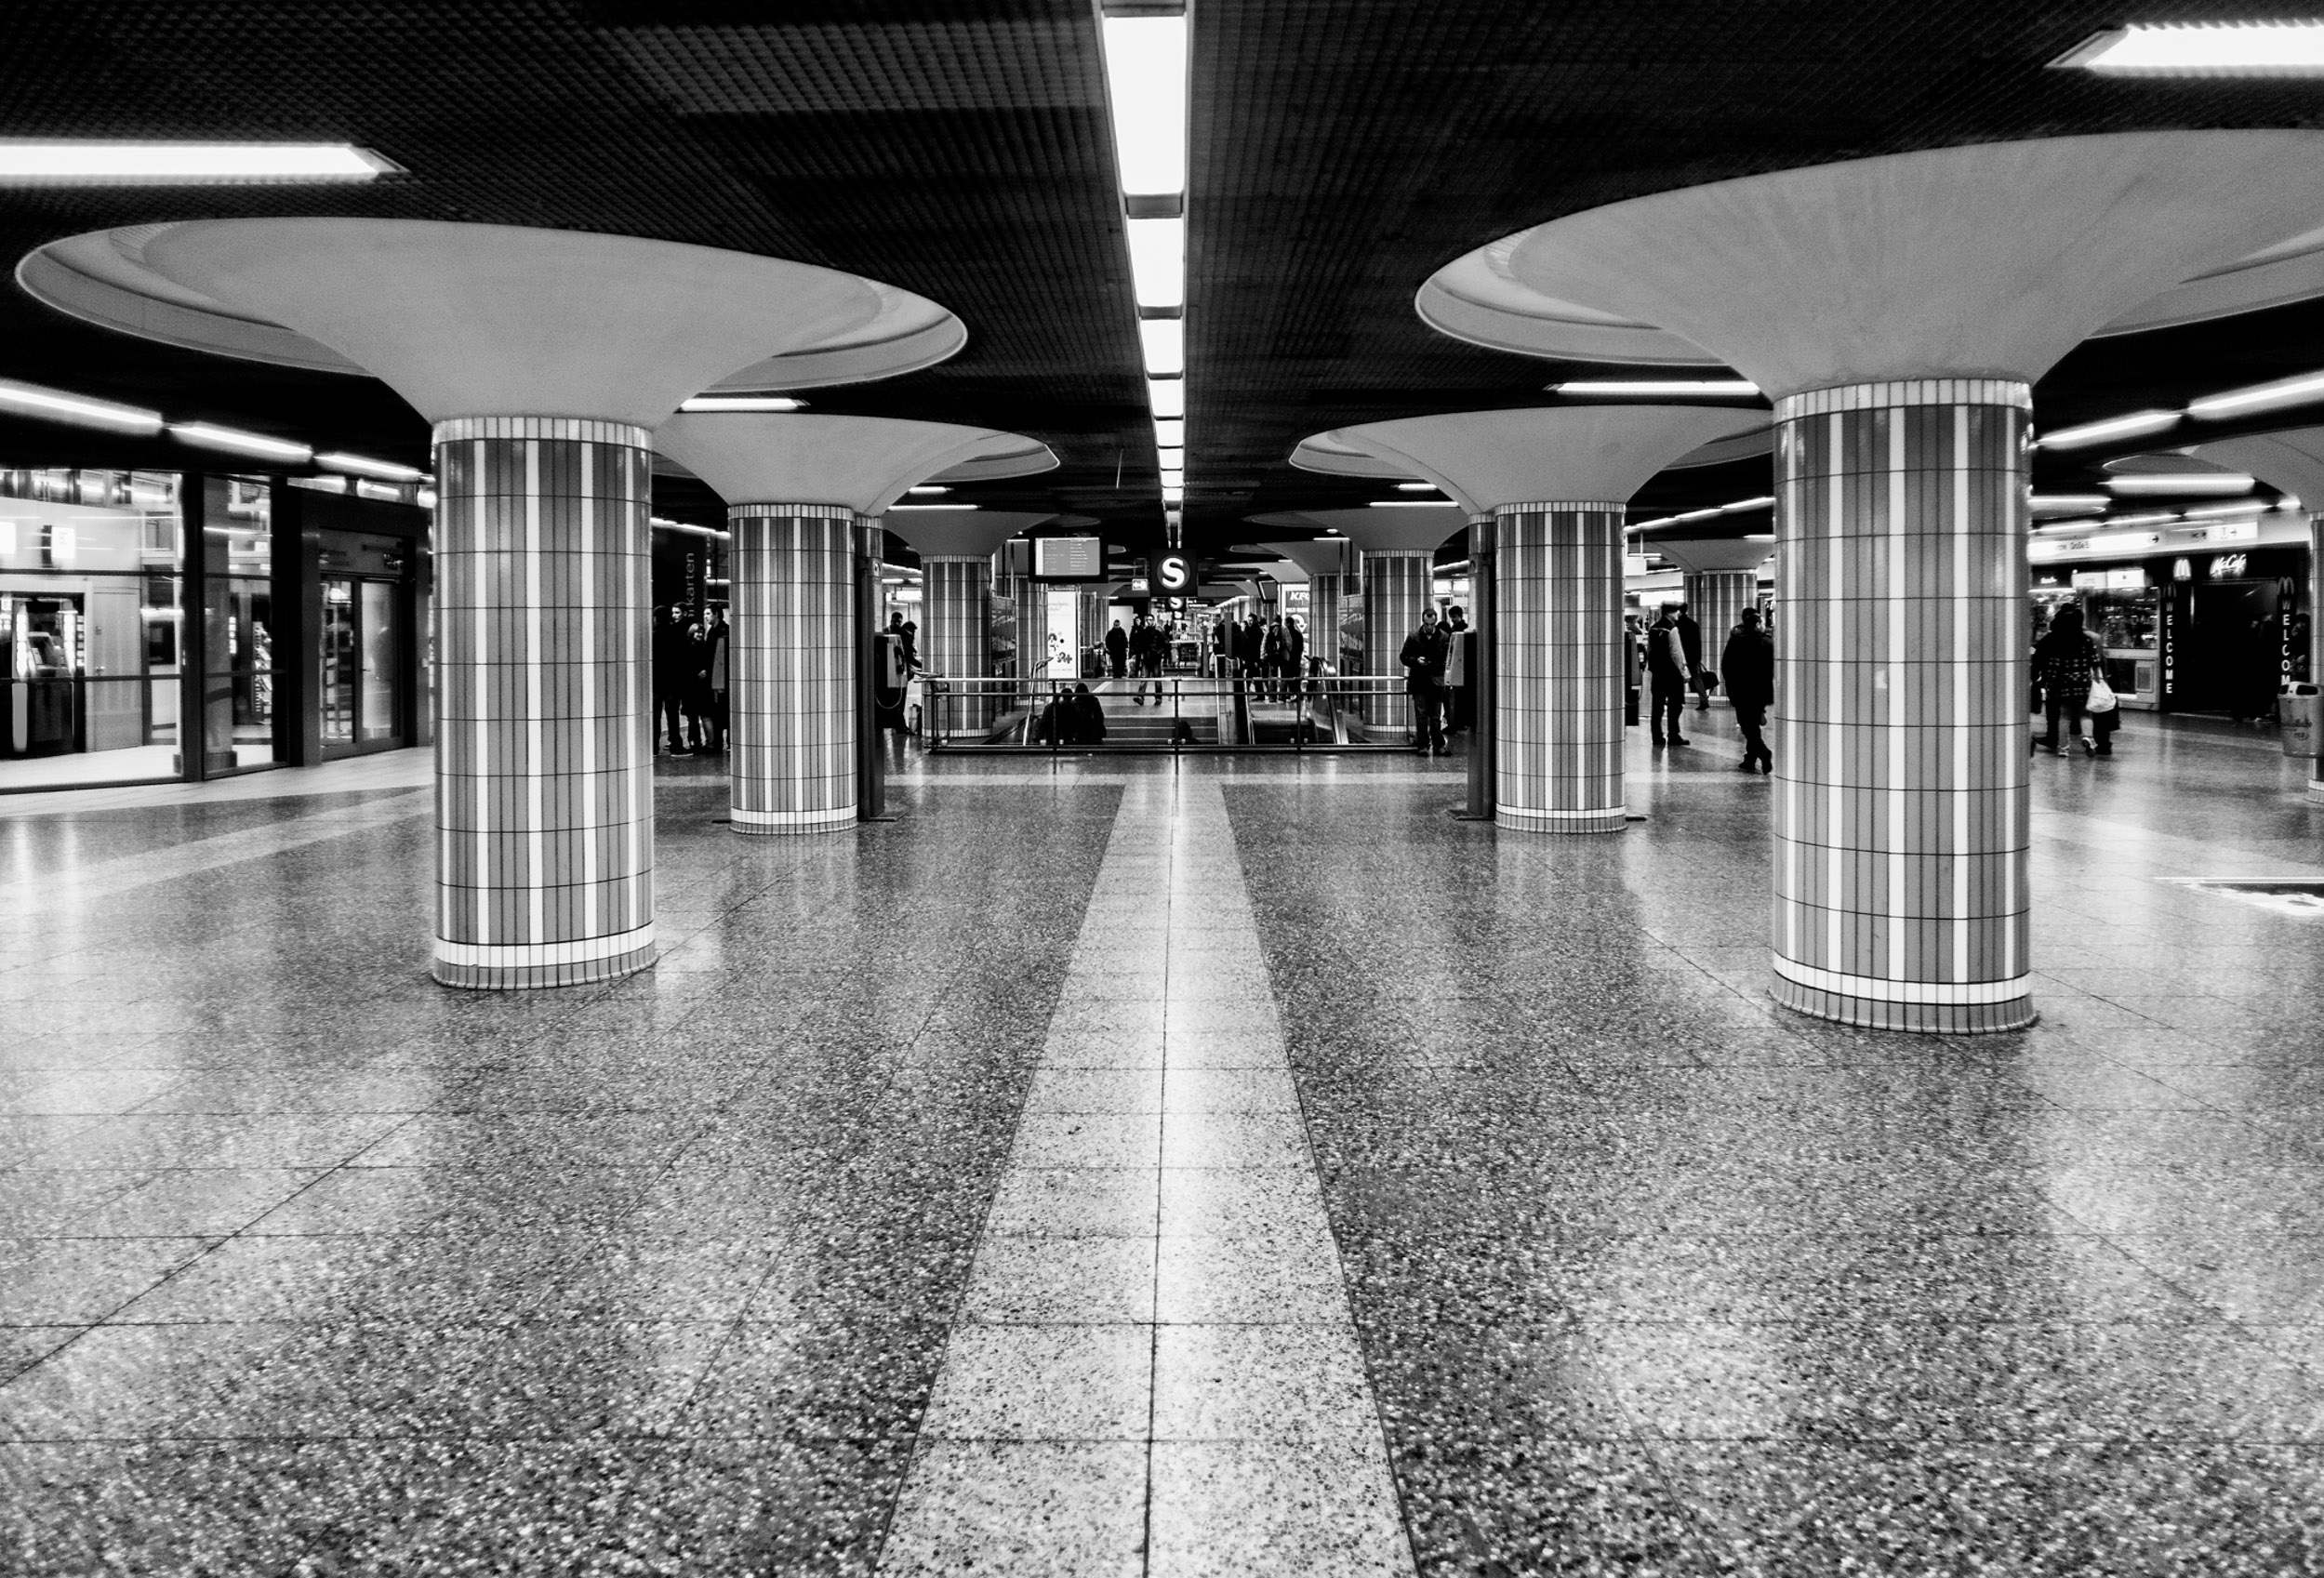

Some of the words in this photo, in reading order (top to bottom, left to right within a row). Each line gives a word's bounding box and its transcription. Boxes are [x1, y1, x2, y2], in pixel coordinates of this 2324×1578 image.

[1162, 557, 1185, 588] S
[2165, 602, 2173, 694] WELCOME
[2281, 599, 2291, 686] WELCOM
